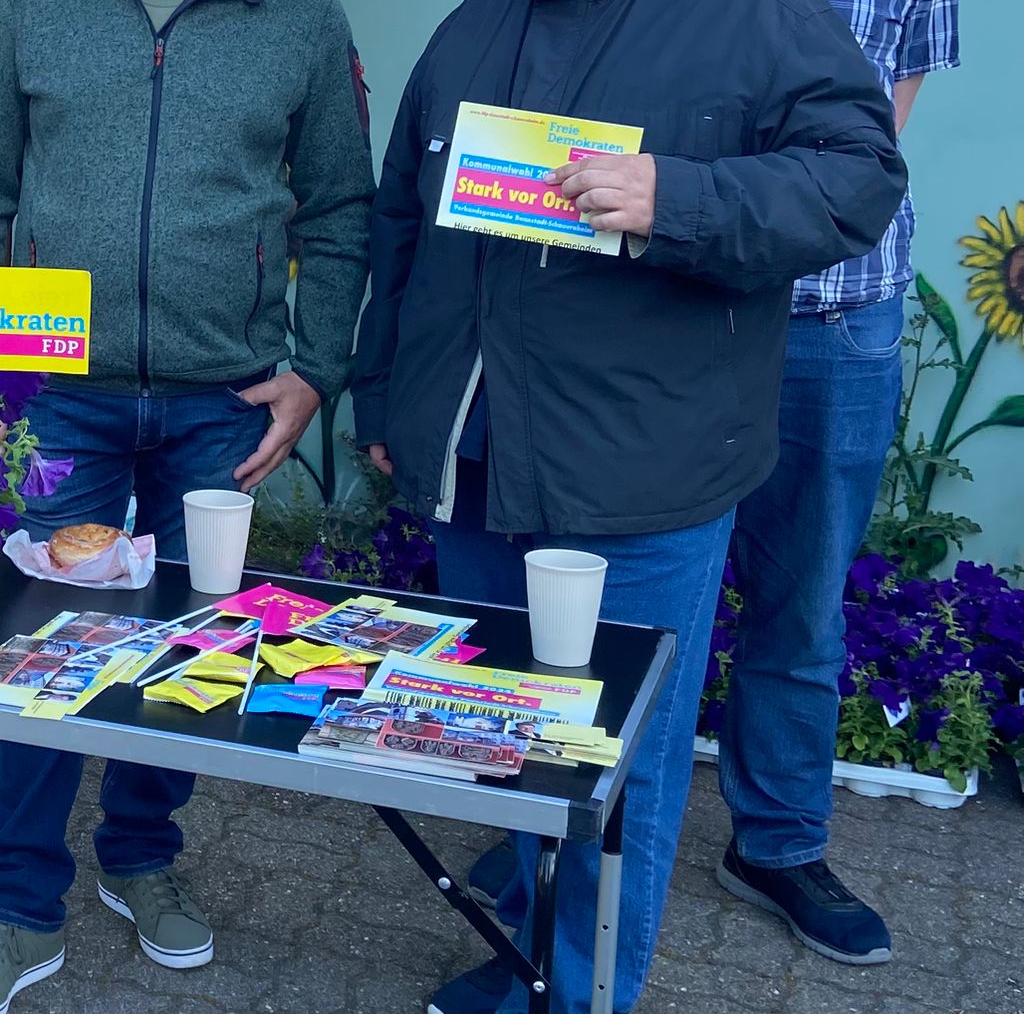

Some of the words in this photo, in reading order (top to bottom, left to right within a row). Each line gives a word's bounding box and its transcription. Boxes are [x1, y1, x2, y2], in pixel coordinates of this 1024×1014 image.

[549, 121, 580, 136] Freie
[547, 132, 624, 154] Demokraten
[462, 157, 534, 178] Kommunalwahl
[536, 170, 550, 180] 20
[456, 176, 504, 200] Stark
[508, 189, 539, 205] vor
[453, 203, 514, 221] Verbandsgemeinde
[454, 221, 472, 231] Hier
[41, 338, 80, 355] FDP
[388, 676, 444, 693] Stark
[451, 688, 486, 700] vor
[491, 693, 533, 707] Ort.
